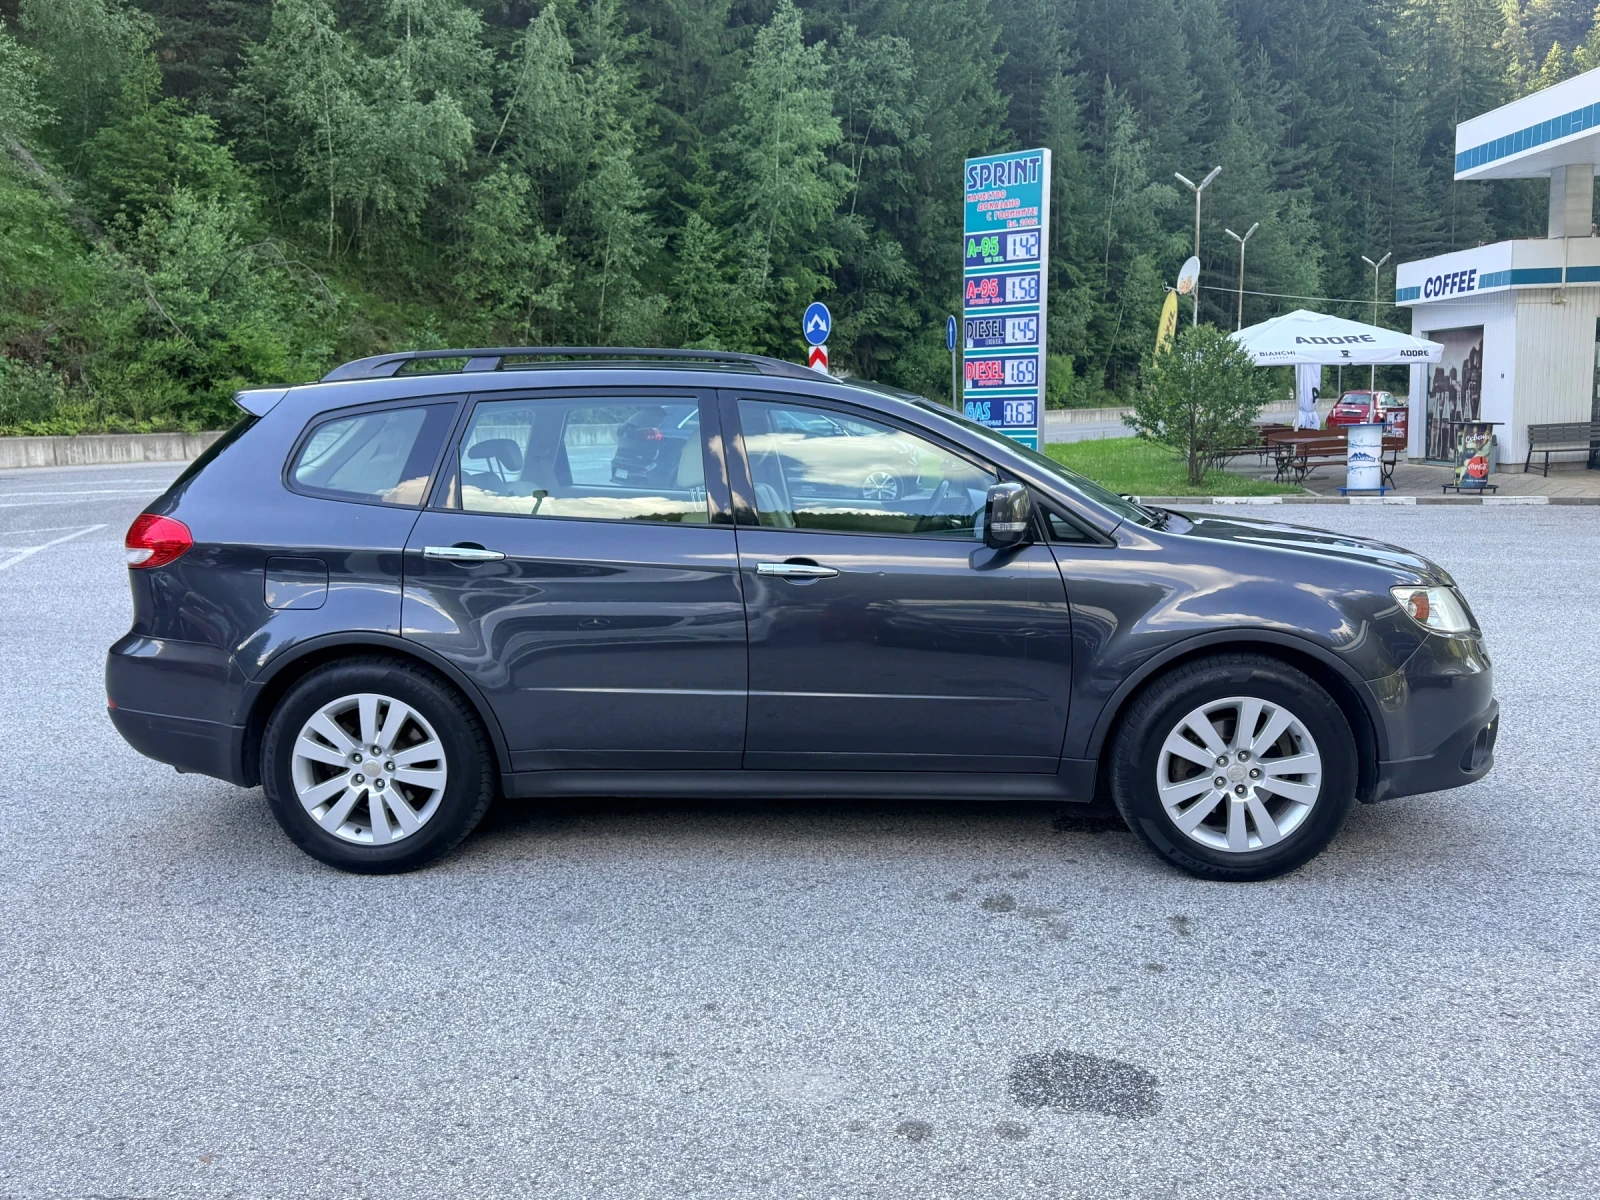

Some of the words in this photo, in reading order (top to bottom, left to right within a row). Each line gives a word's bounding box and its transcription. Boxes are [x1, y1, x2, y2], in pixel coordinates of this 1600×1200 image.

[967, 156, 1041, 191] SPRINT
[967, 189, 1006, 203] КАЧЕСТВО
[977, 198, 1020, 212] ДОКАЗАНО
[967, 236, 999, 258] A-95
[1013, 234, 1038, 257] 1.42
[966, 278, 998, 299] A-95
[1012, 277, 1038, 299] 1.58
[1424, 268, 1477, 299] COFFEE
[966, 318, 1005, 339] DIESEL
[1012, 318, 1036, 341] 1.45
[1295, 334, 1376, 345] ADORE
[966, 360, 1004, 380] DIESEL
[1011, 360, 1035, 383] 1.69
[965, 401, 991, 420] GAS
[1004, 402, 1034, 423] 0.63
